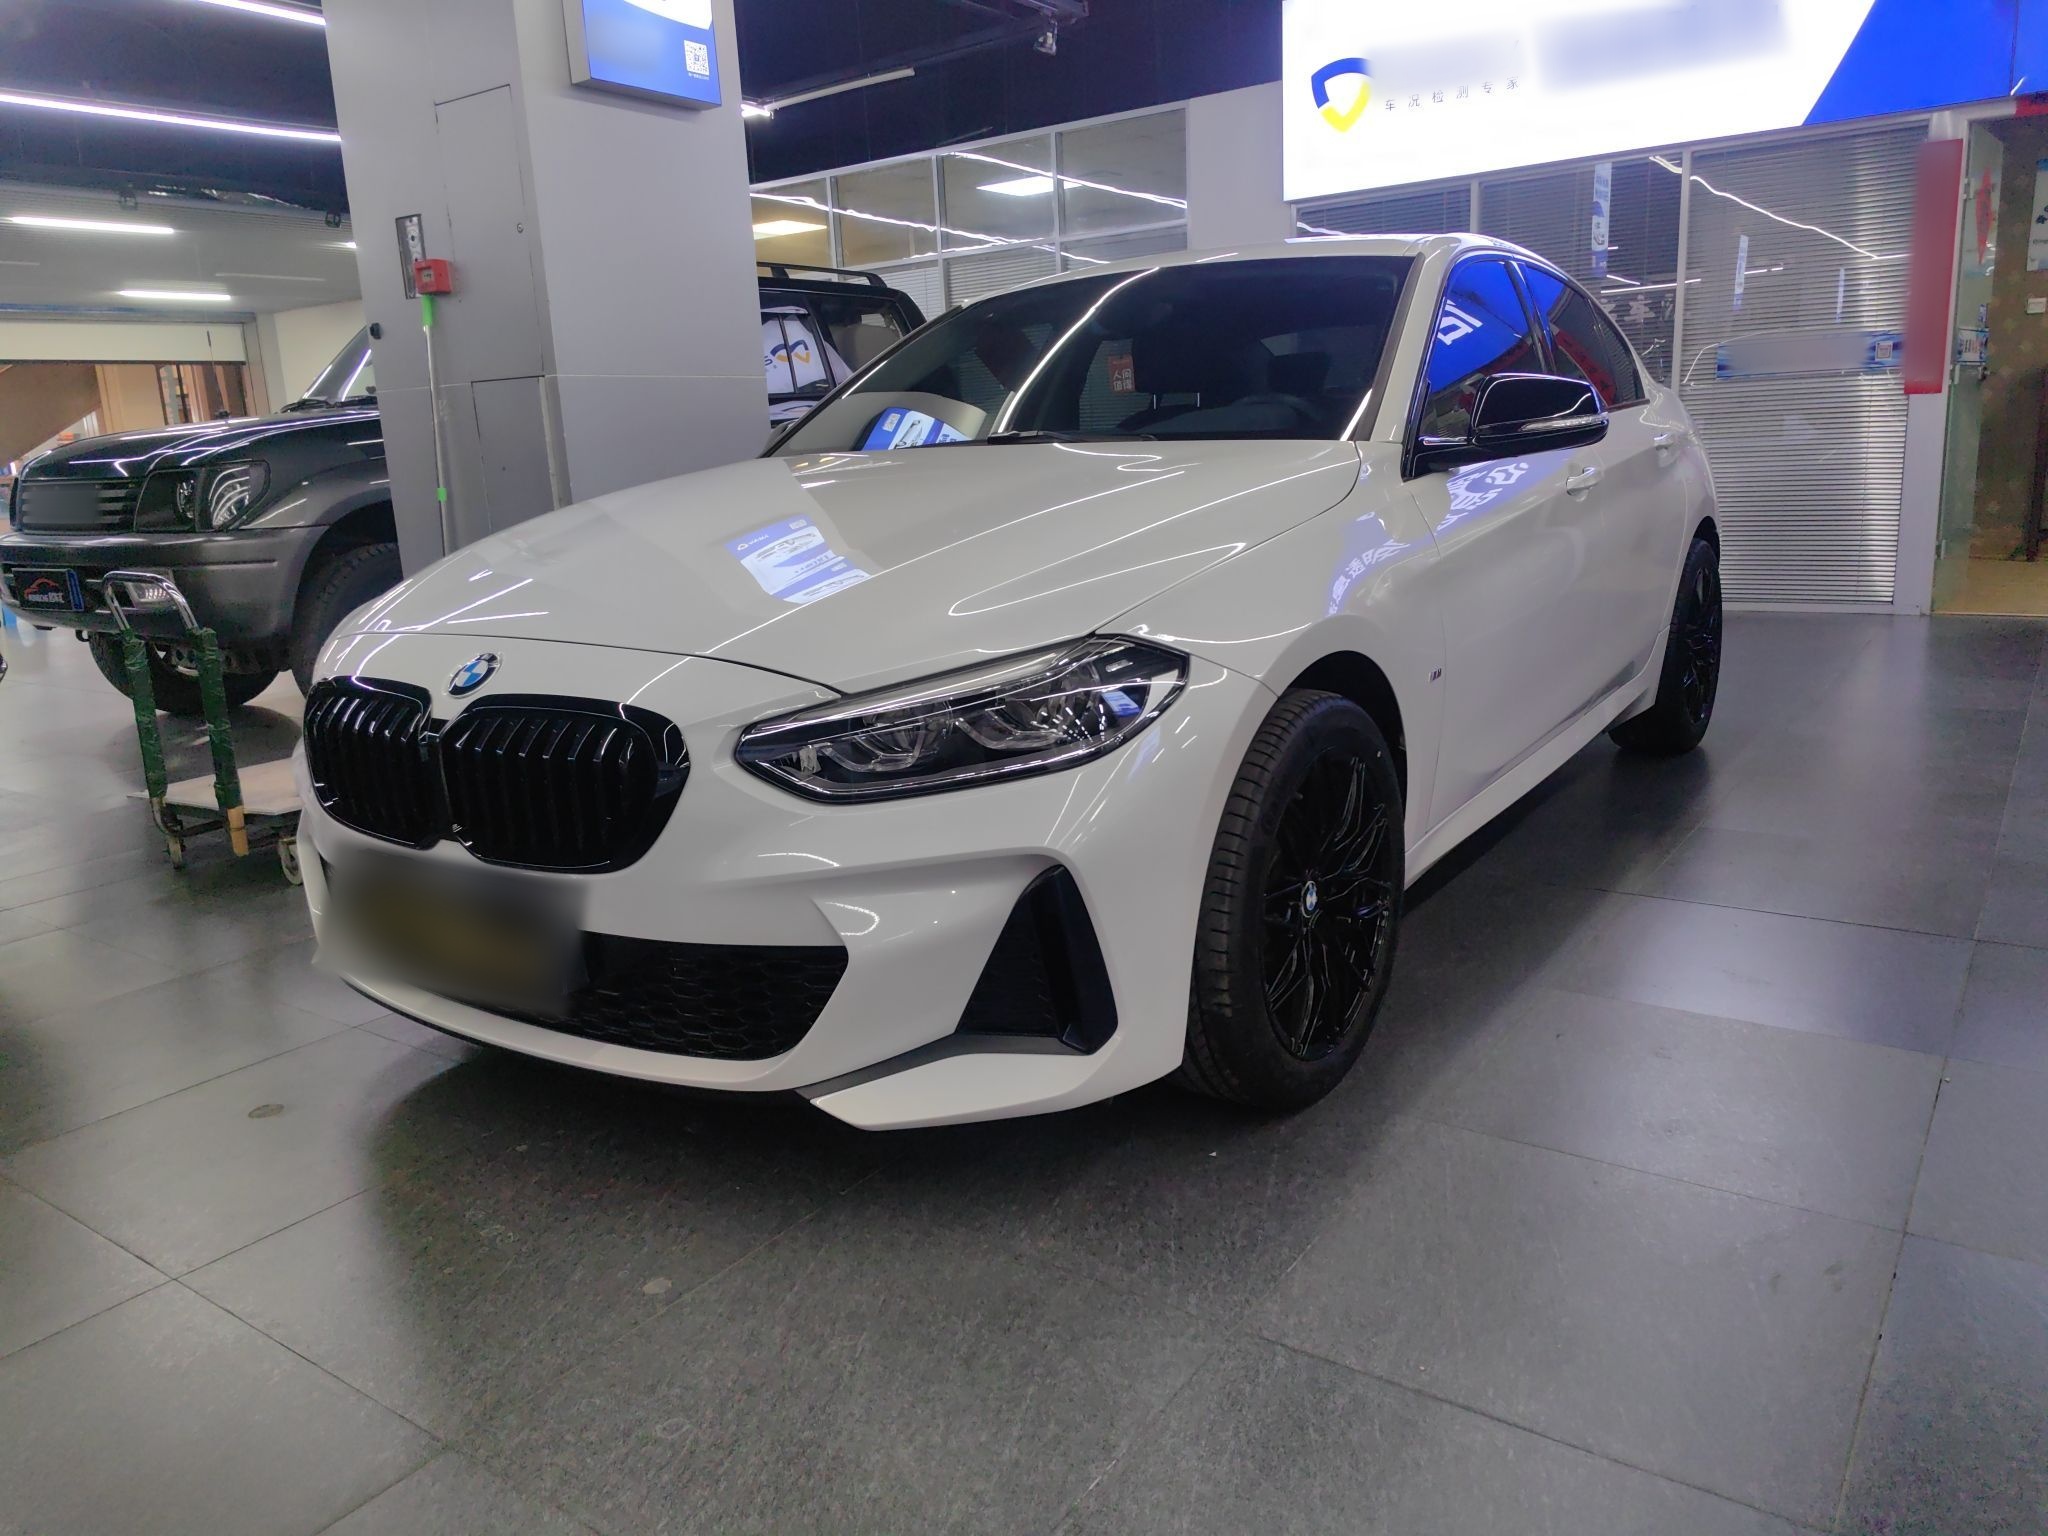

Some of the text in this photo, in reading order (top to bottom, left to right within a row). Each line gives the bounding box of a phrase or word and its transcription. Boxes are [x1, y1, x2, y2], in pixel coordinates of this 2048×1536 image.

[1384, 76, 1519, 112] 车况检测专家
